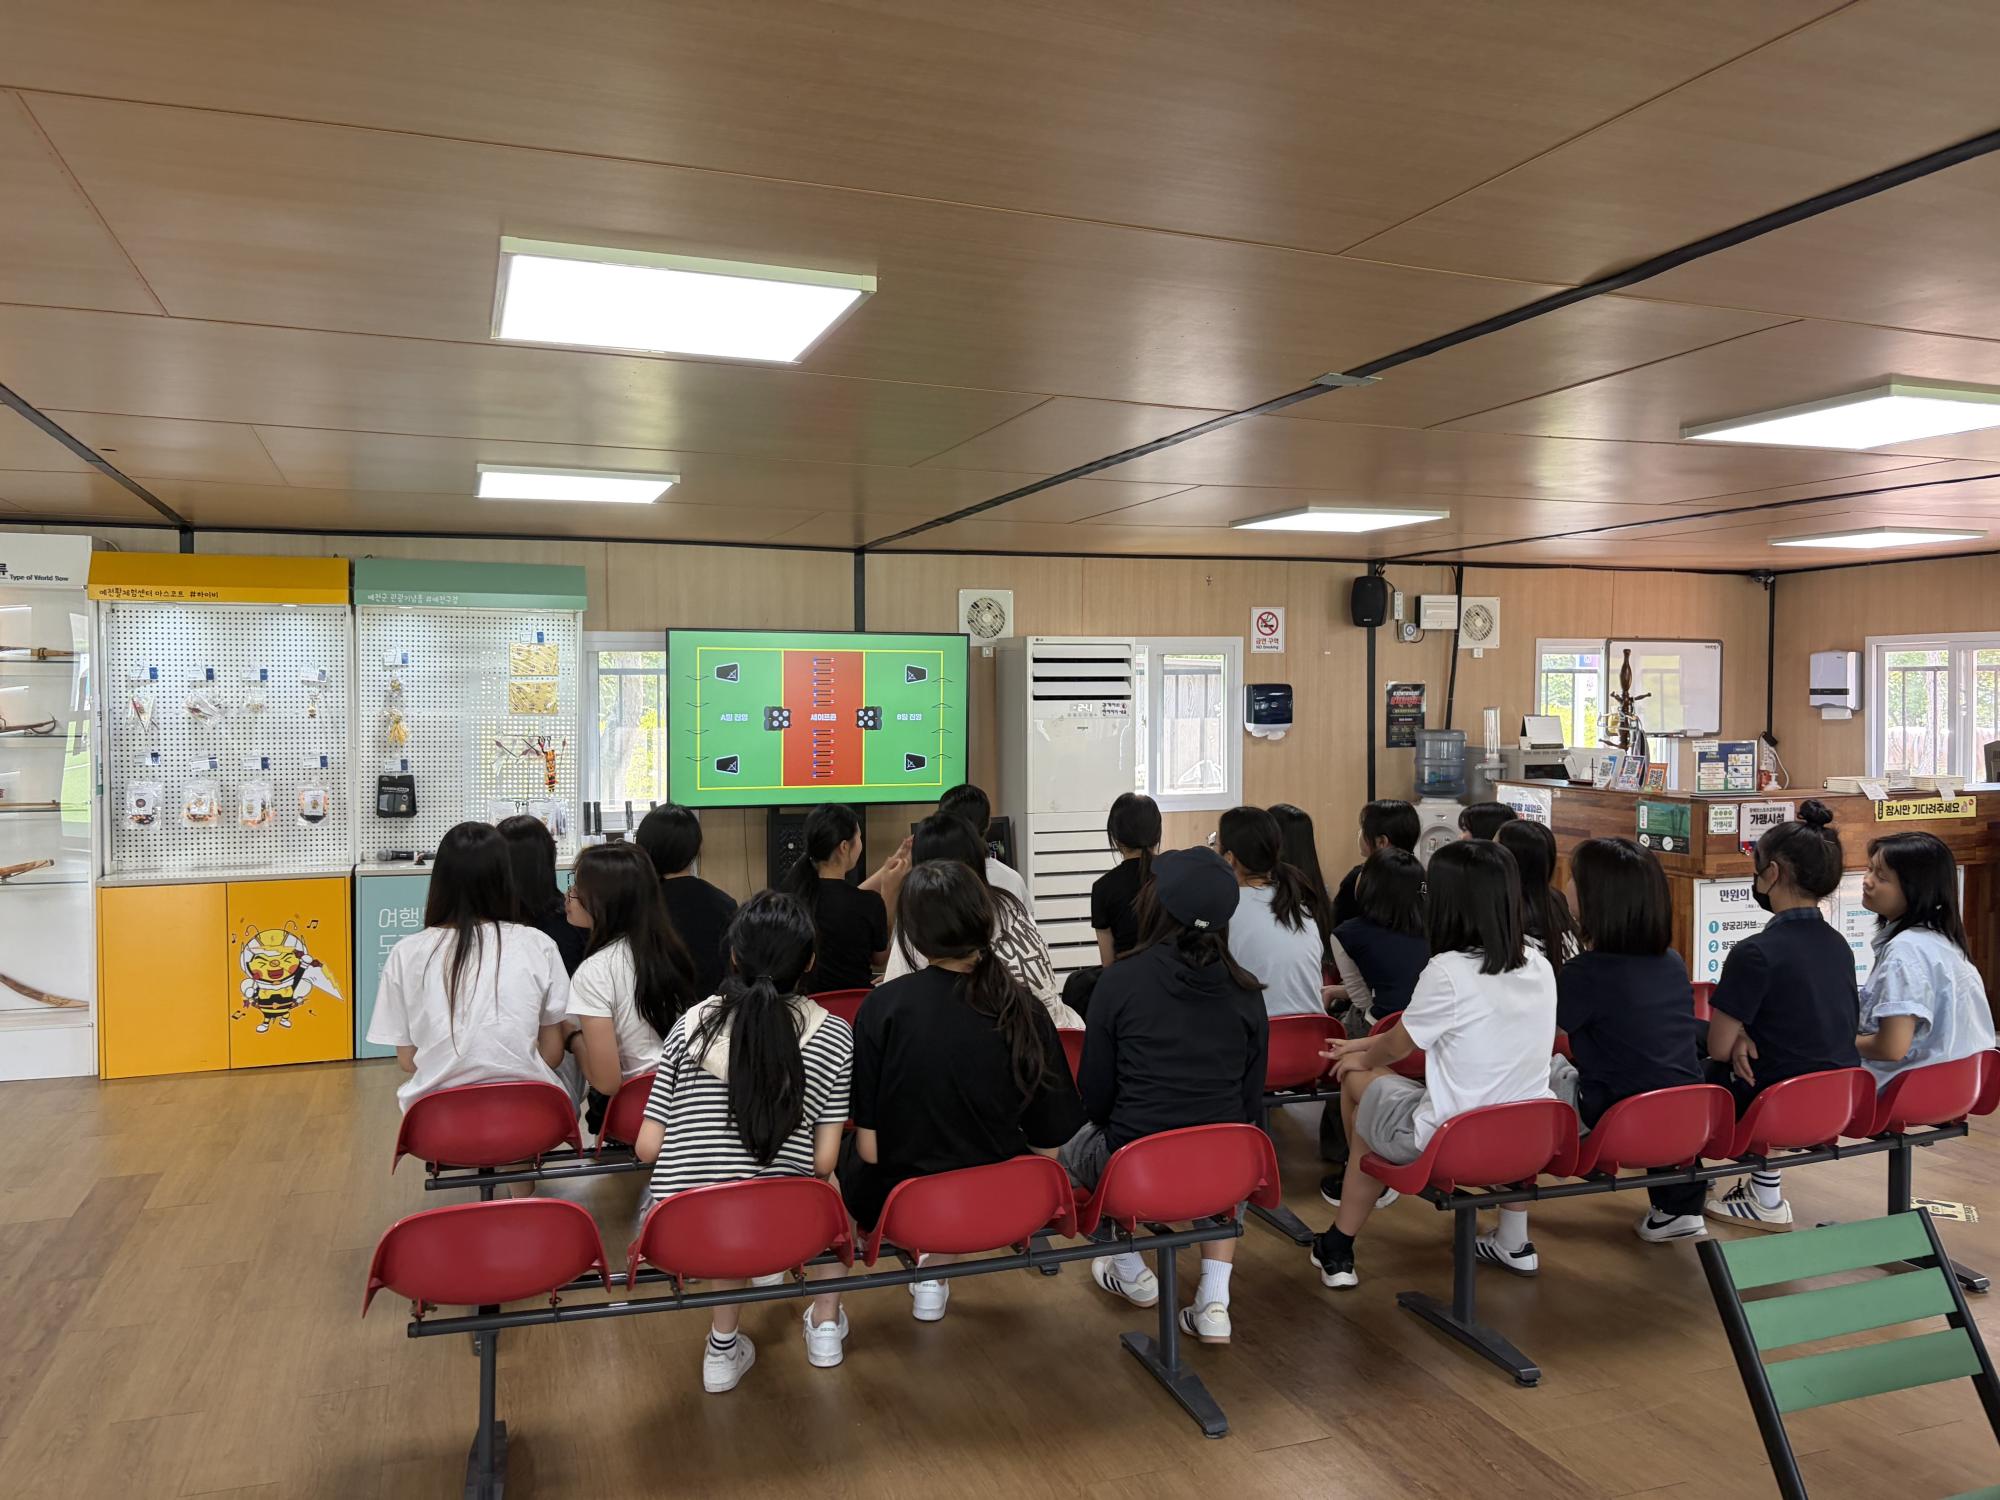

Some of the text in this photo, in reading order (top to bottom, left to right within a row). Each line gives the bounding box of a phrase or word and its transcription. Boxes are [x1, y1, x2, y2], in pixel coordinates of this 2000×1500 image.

[1886, 802, 1960, 816] 잠시만 기다려주세요
[1750, 813, 1785, 825] 가맹시설
[1720, 888, 1750, 902] 만원의
[378, 907, 425, 928] 여행
[1721, 920, 1757, 931] 양궁리커브
